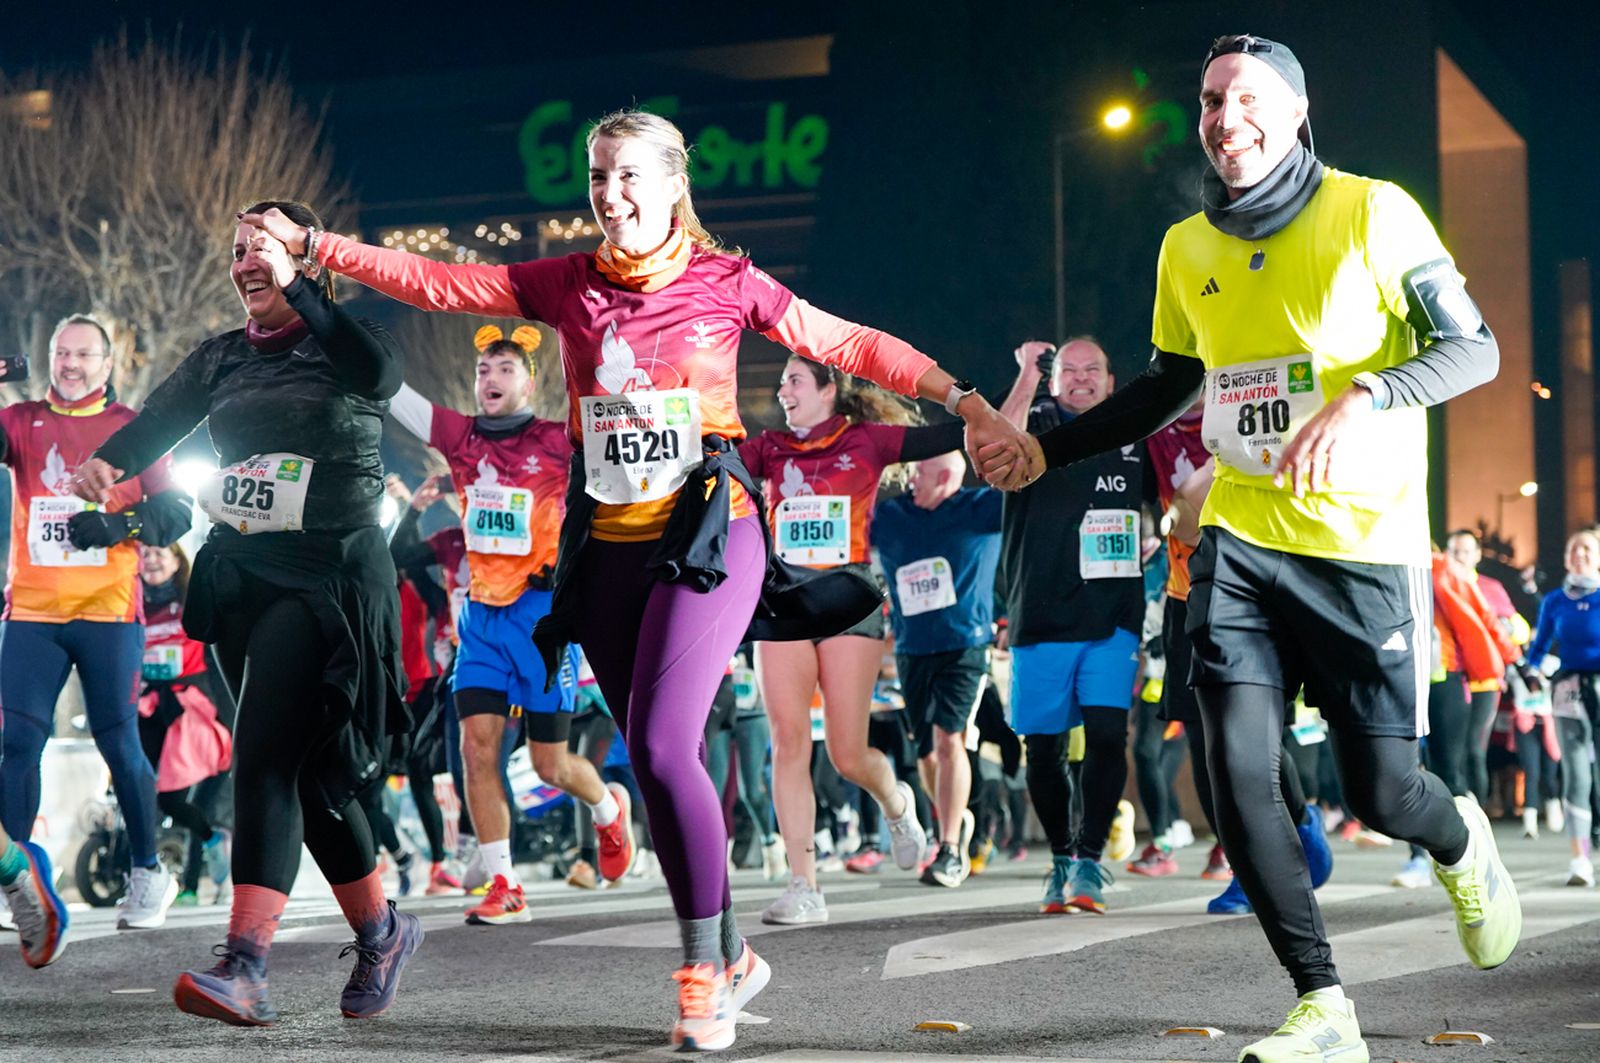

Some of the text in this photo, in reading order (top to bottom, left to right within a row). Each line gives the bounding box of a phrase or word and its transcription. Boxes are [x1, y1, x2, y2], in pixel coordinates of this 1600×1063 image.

[1231, 373, 1263, 389] NOCHE
[1266, 371, 1278, 384] DE
[1218, 391, 1241, 405] SAN
[1242, 384, 1279, 401] ANTÓN
[606, 405, 638, 418] NOCHE
[639, 404, 653, 415] DE
[1237, 399, 1290, 436] 810
[594, 419, 615, 433] SAN
[604, 429, 679, 466] 4529
[1248, 437, 1282, 446] Fernando
[222, 475, 275, 511] 825
[1095, 475, 1127, 492] AIG
[221, 506, 271, 521] FRANCISAC EVA
[476, 509, 515, 531] 8149
[790, 520, 834, 541] 8150
[1096, 534, 1130, 555] 8151
